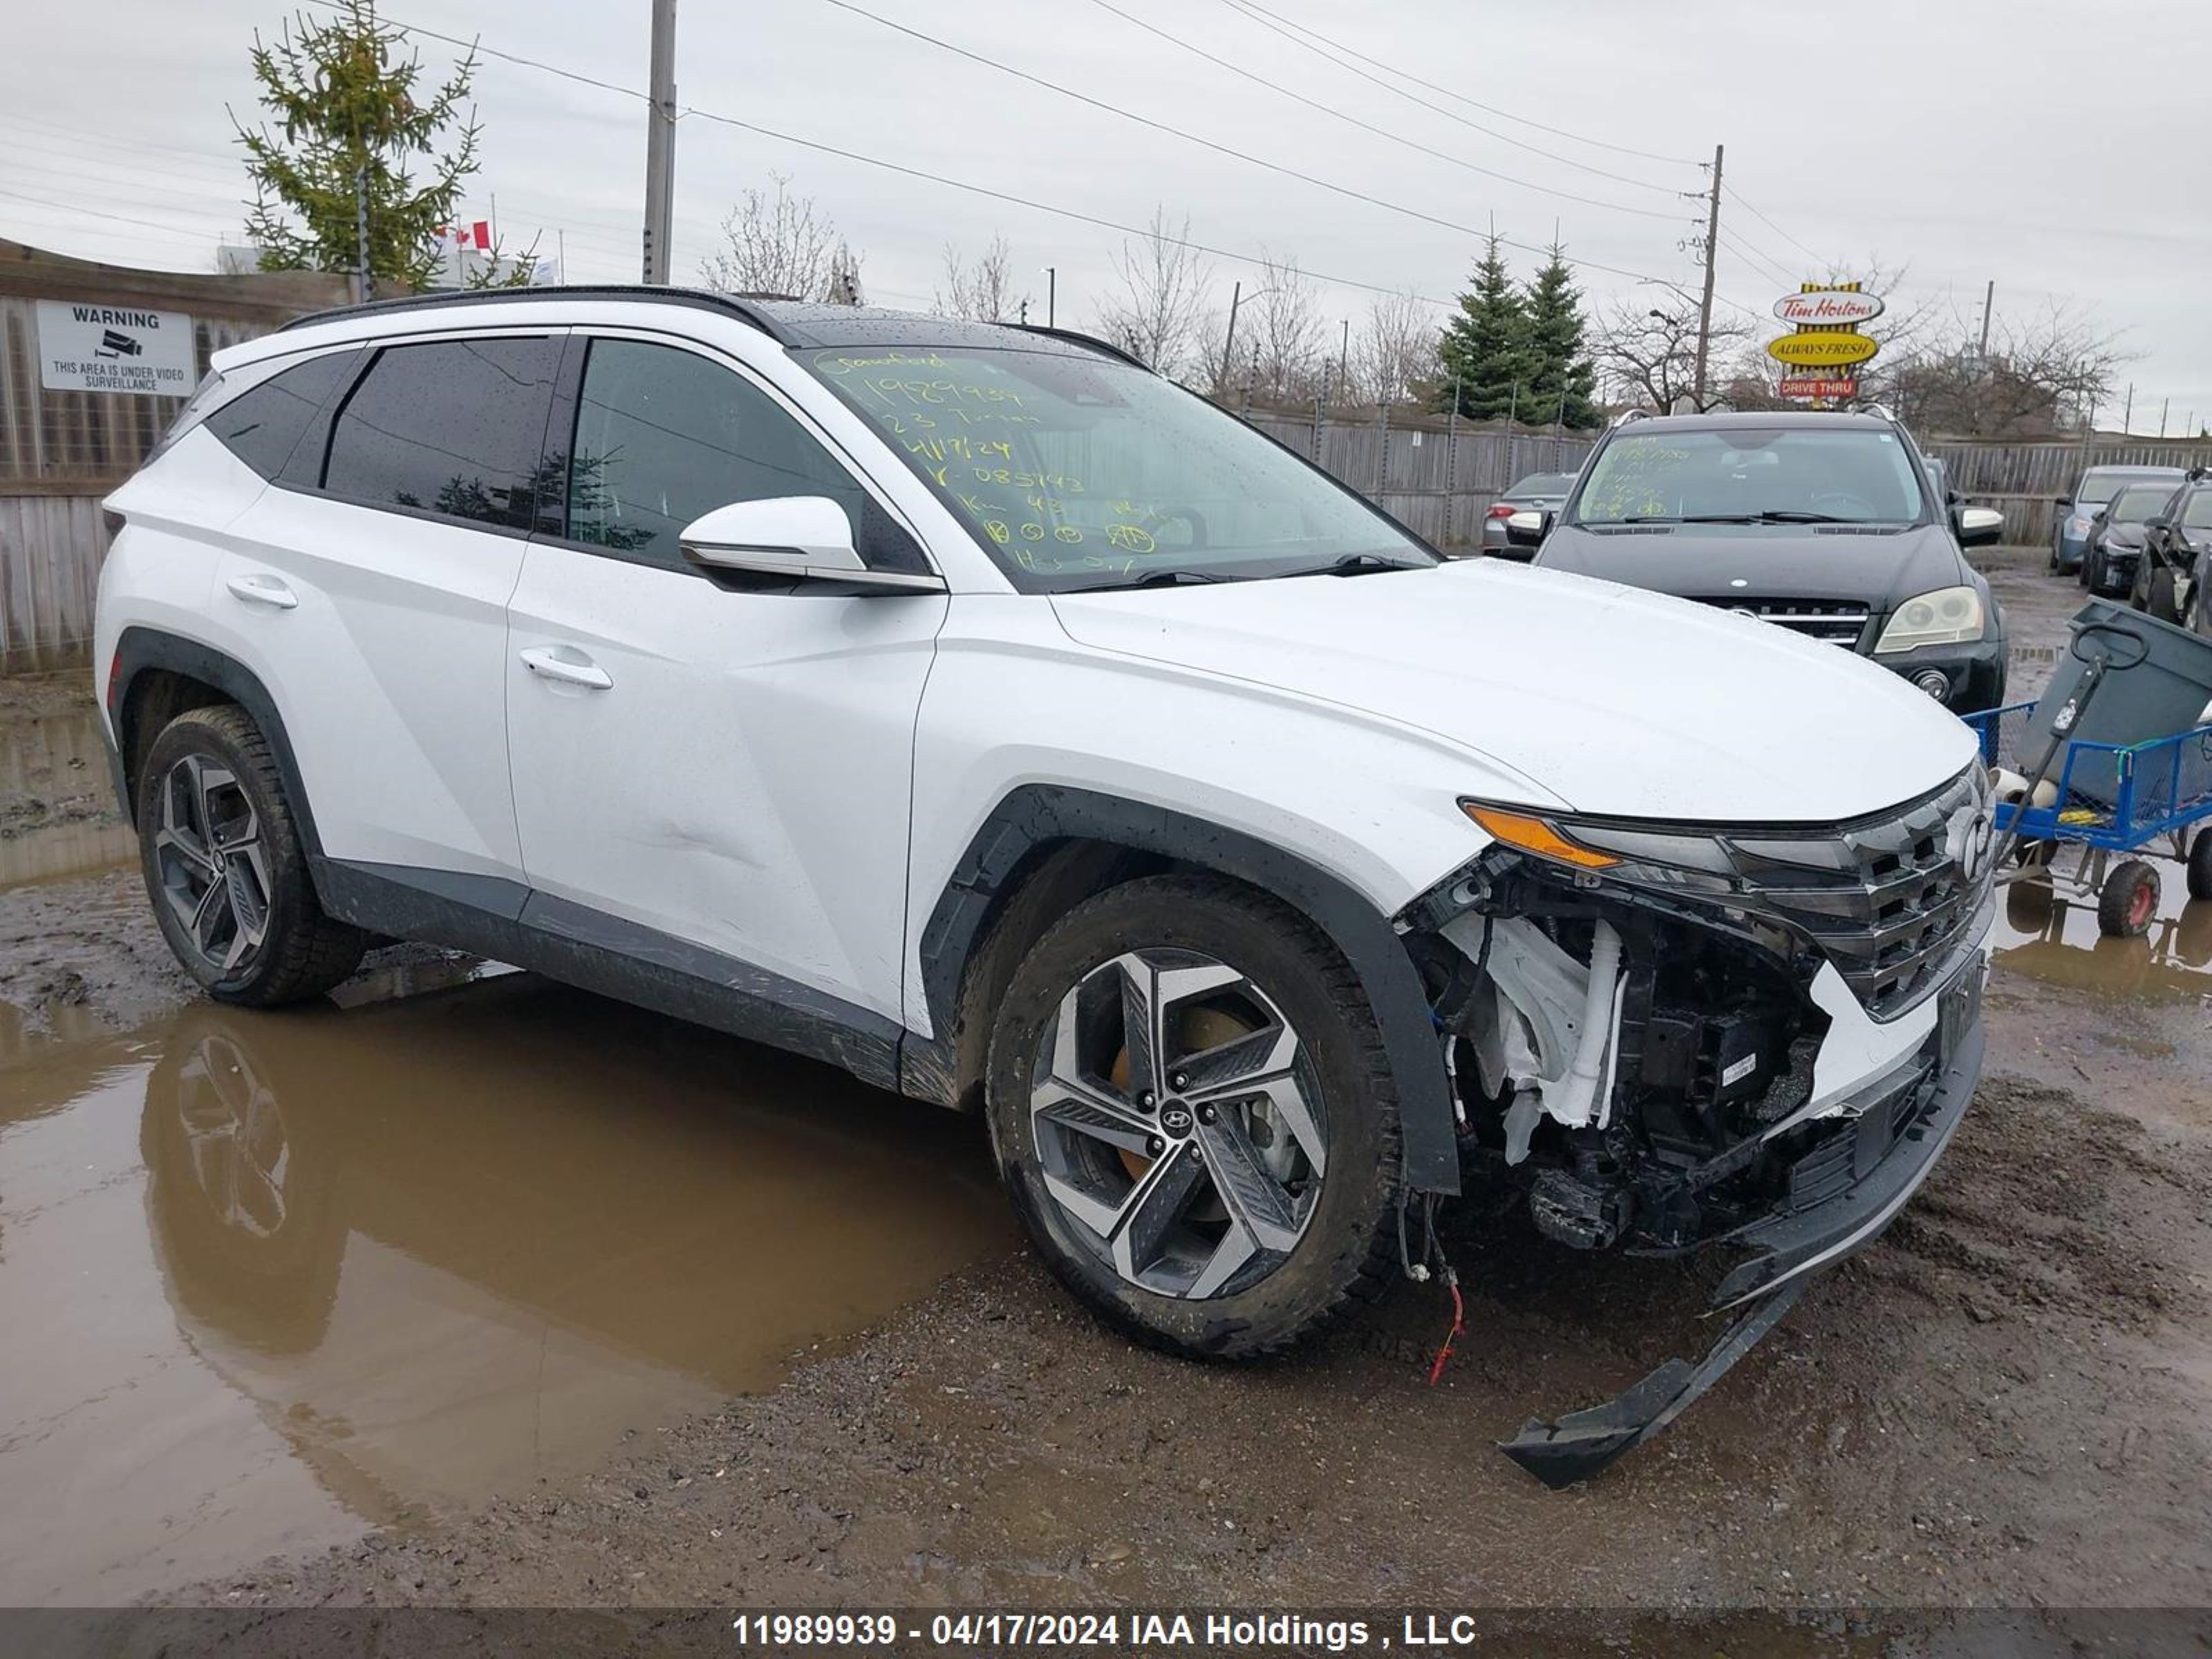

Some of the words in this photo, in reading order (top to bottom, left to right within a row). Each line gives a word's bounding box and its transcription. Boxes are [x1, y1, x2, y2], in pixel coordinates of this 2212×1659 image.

[1784, 298, 1812, 317] Tim
[1814, 298, 1873, 317] Hortons
[73, 306, 160, 329] WARNING
[1776, 343, 1824, 355] ALWAYS
[1826, 343, 1871, 355] FRESH
[53, 361, 77, 374] THIS
[80, 363, 106, 376] AREA
[109, 365, 118, 376] IS
[121, 366, 154, 379] UNDER
[156, 368, 185, 381] VIDEO
[85, 375, 158, 392] SURVEILLANCE
[1782, 382, 1815, 394] DRIVE
[1821, 382, 1853, 394] THRU
